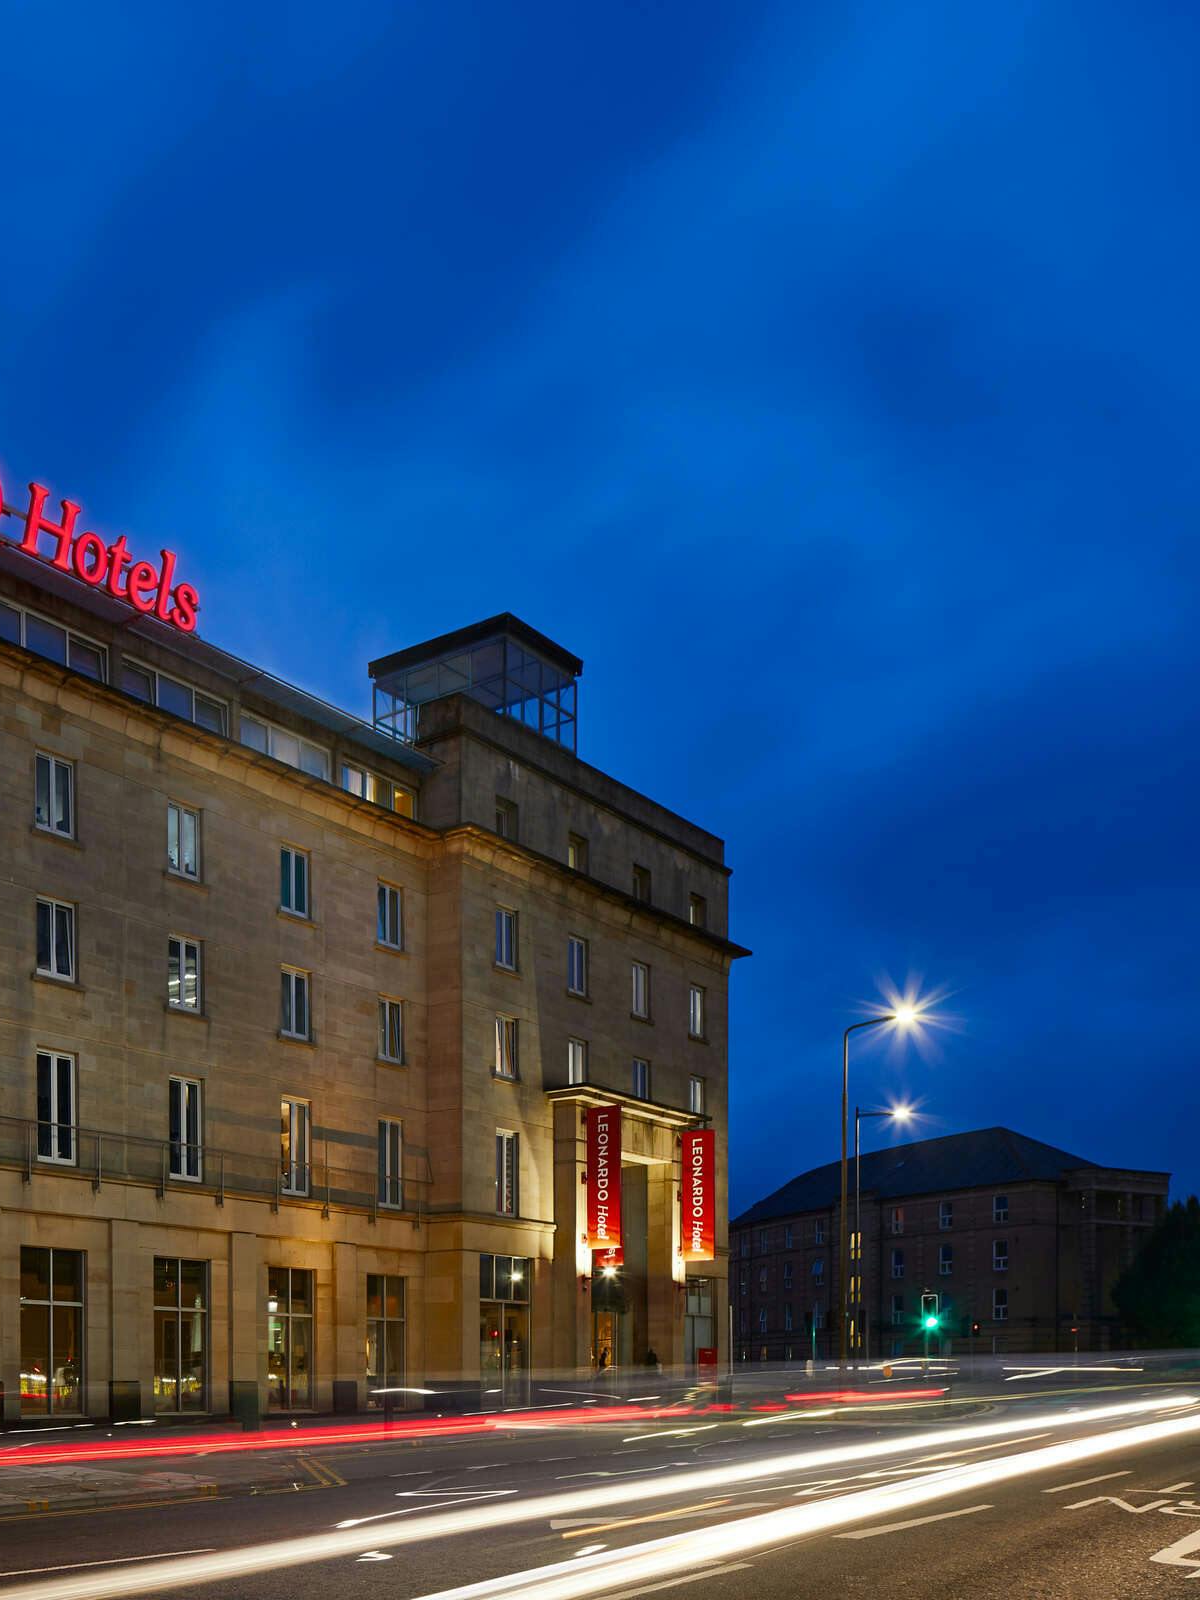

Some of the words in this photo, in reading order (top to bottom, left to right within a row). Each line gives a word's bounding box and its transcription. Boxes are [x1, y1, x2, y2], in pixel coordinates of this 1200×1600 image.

[19, 481, 200, 634] Hotels
[597, 1114, 608, 1201] LEONARDO
[692, 1138, 703, 1217] LEONARDO
[597, 1205, 609, 1240] Hotel
[692, 1221, 704, 1252] Hotel
